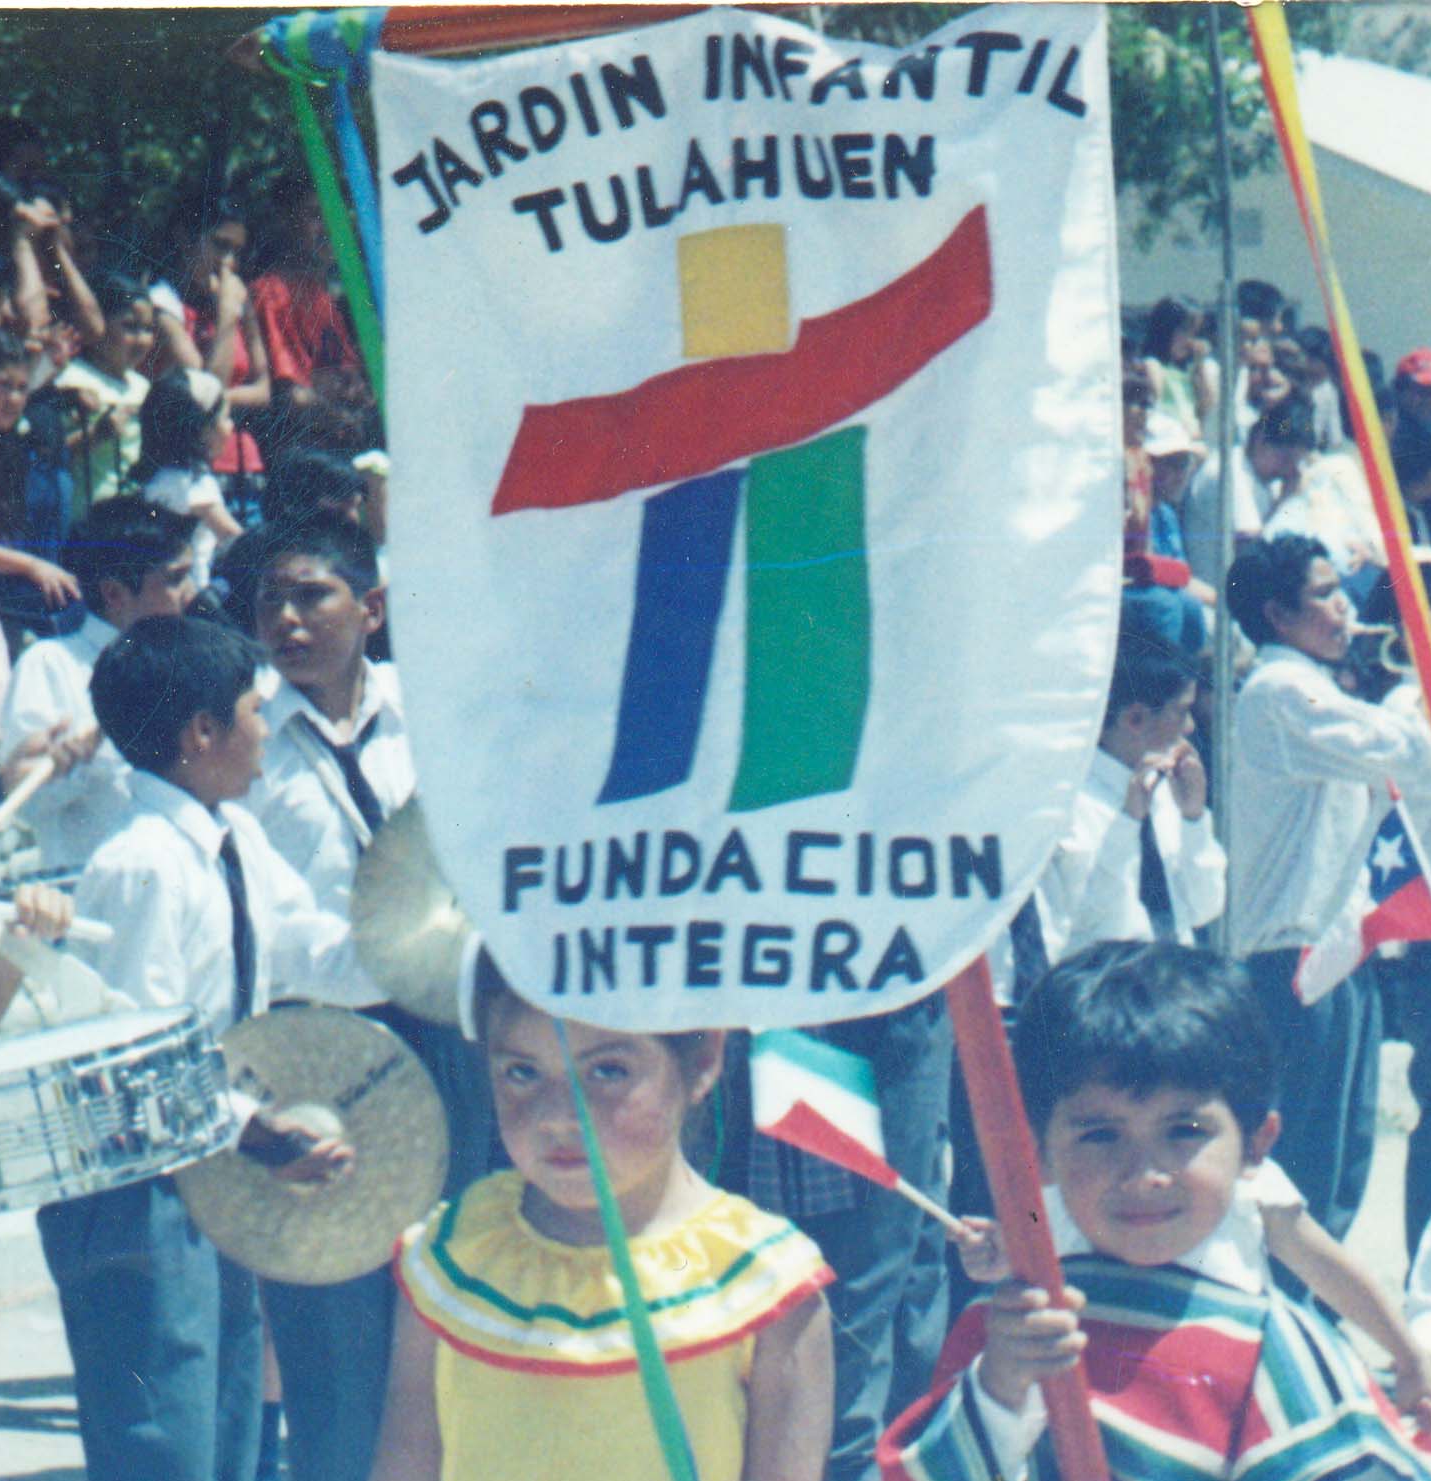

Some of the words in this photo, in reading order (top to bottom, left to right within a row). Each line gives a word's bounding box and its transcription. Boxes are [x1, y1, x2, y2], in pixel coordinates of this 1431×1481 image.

[392, 54, 667, 234] JARDIN
[704, 31, 1087, 117] INFANTIL
[513, 132, 936, 252] TULAHUEN
[503, 828, 1002, 911] FUNDACION
[553, 919, 925, 993] INTEGRA
